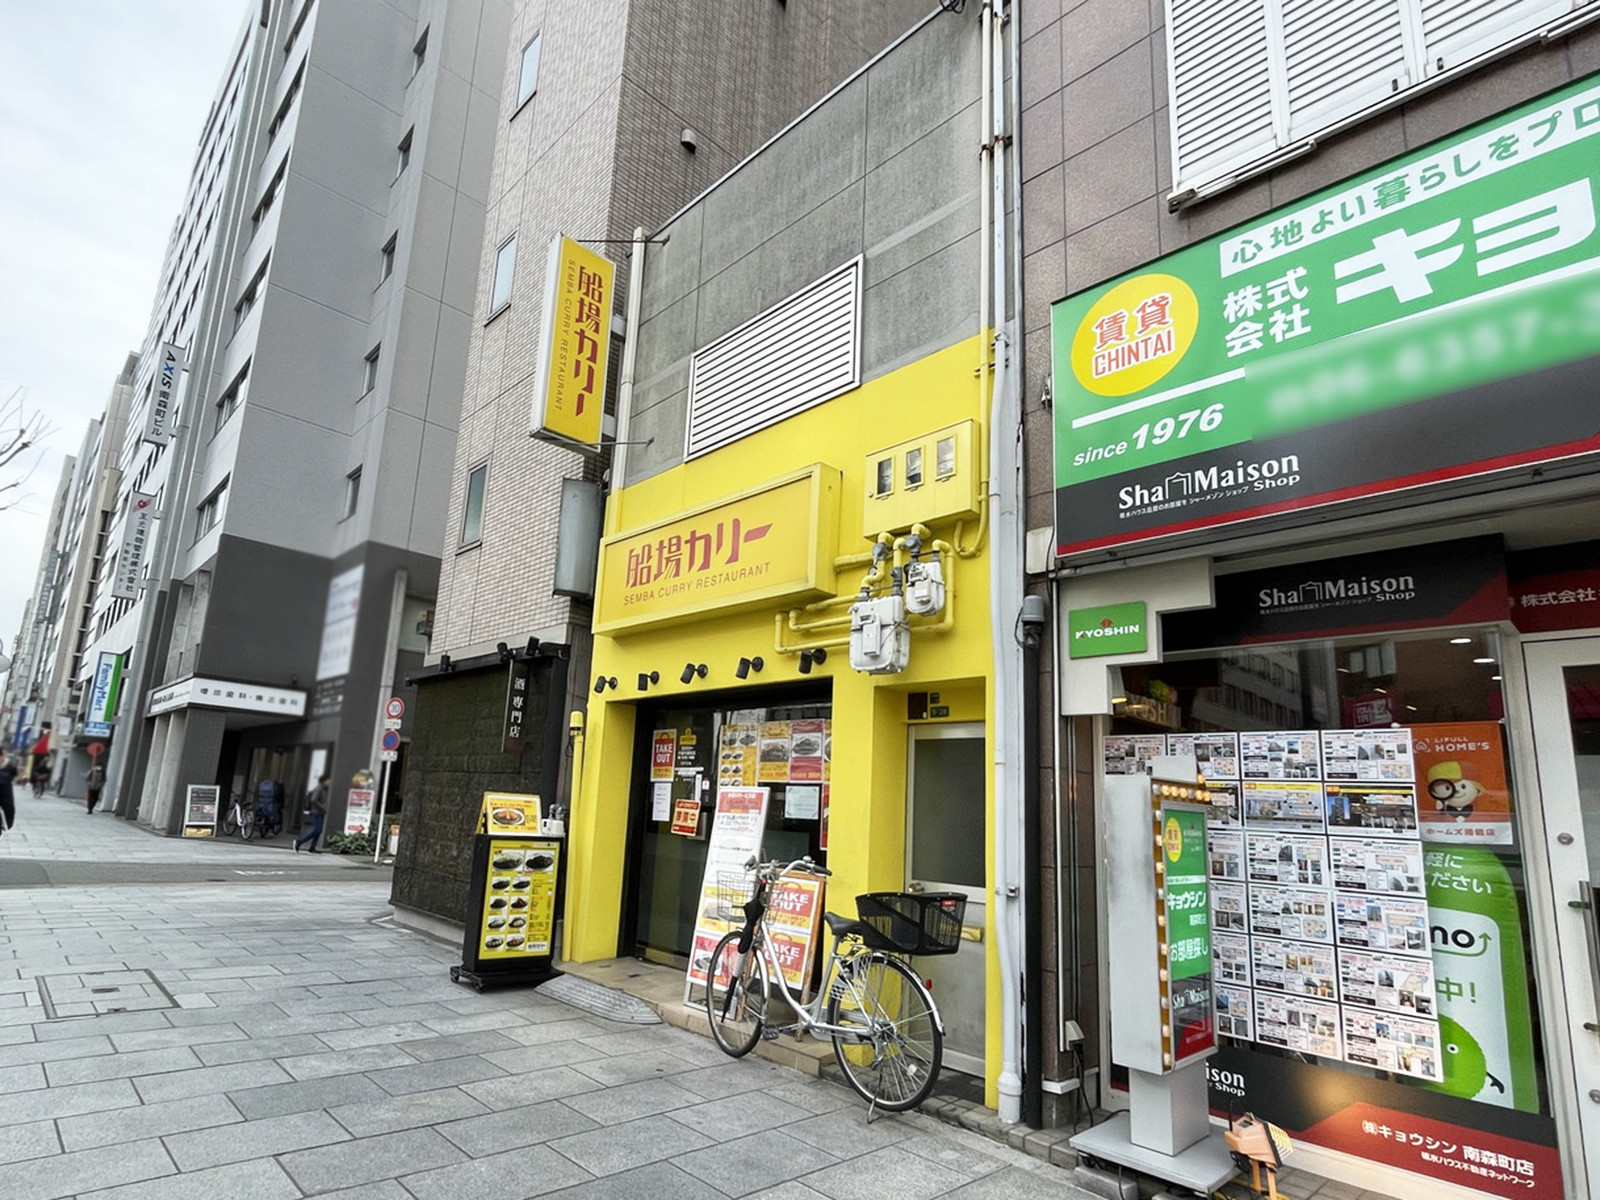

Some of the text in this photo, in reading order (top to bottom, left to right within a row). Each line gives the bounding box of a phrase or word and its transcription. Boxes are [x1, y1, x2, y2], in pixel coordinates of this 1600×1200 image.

[1222, 266, 1309, 324] 株式
[554, 258, 576, 411] SEMBA CURRY RESTAURANT
[574, 265, 603, 417] 船場カリー
[1092, 294, 1173, 351] 賃貸
[1225, 304, 1312, 359] 会社
[161, 350, 177, 390] AXIS
[1092, 328, 1173, 379] CHINTAI
[1073, 403, 1224, 467] since 1976
[1118, 454, 1300, 510] Sha Maison
[1253, 475, 1300, 492] Shop
[626, 518, 773, 588] 船場カリー
[624, 562, 771, 606] SEMBA CURRY RESTAURANT
[1259, 574, 1415, 608] Sha Maison
[1375, 591, 1416, 602] Shop
[1521, 587, 1597, 608] 株式会社
[1075, 624, 1139, 639] KYOSHIN
[93, 663, 113, 711] FamilyMart
[390, 703, 400, 713] 30
[655, 743, 673, 754] TAKE
[656, 753, 671, 763] OUT
[1435, 742, 1490, 752] HOME'S
[1215, 1082, 1246, 1097] Shop
[1463, 1145, 1534, 1176] 南森町店
